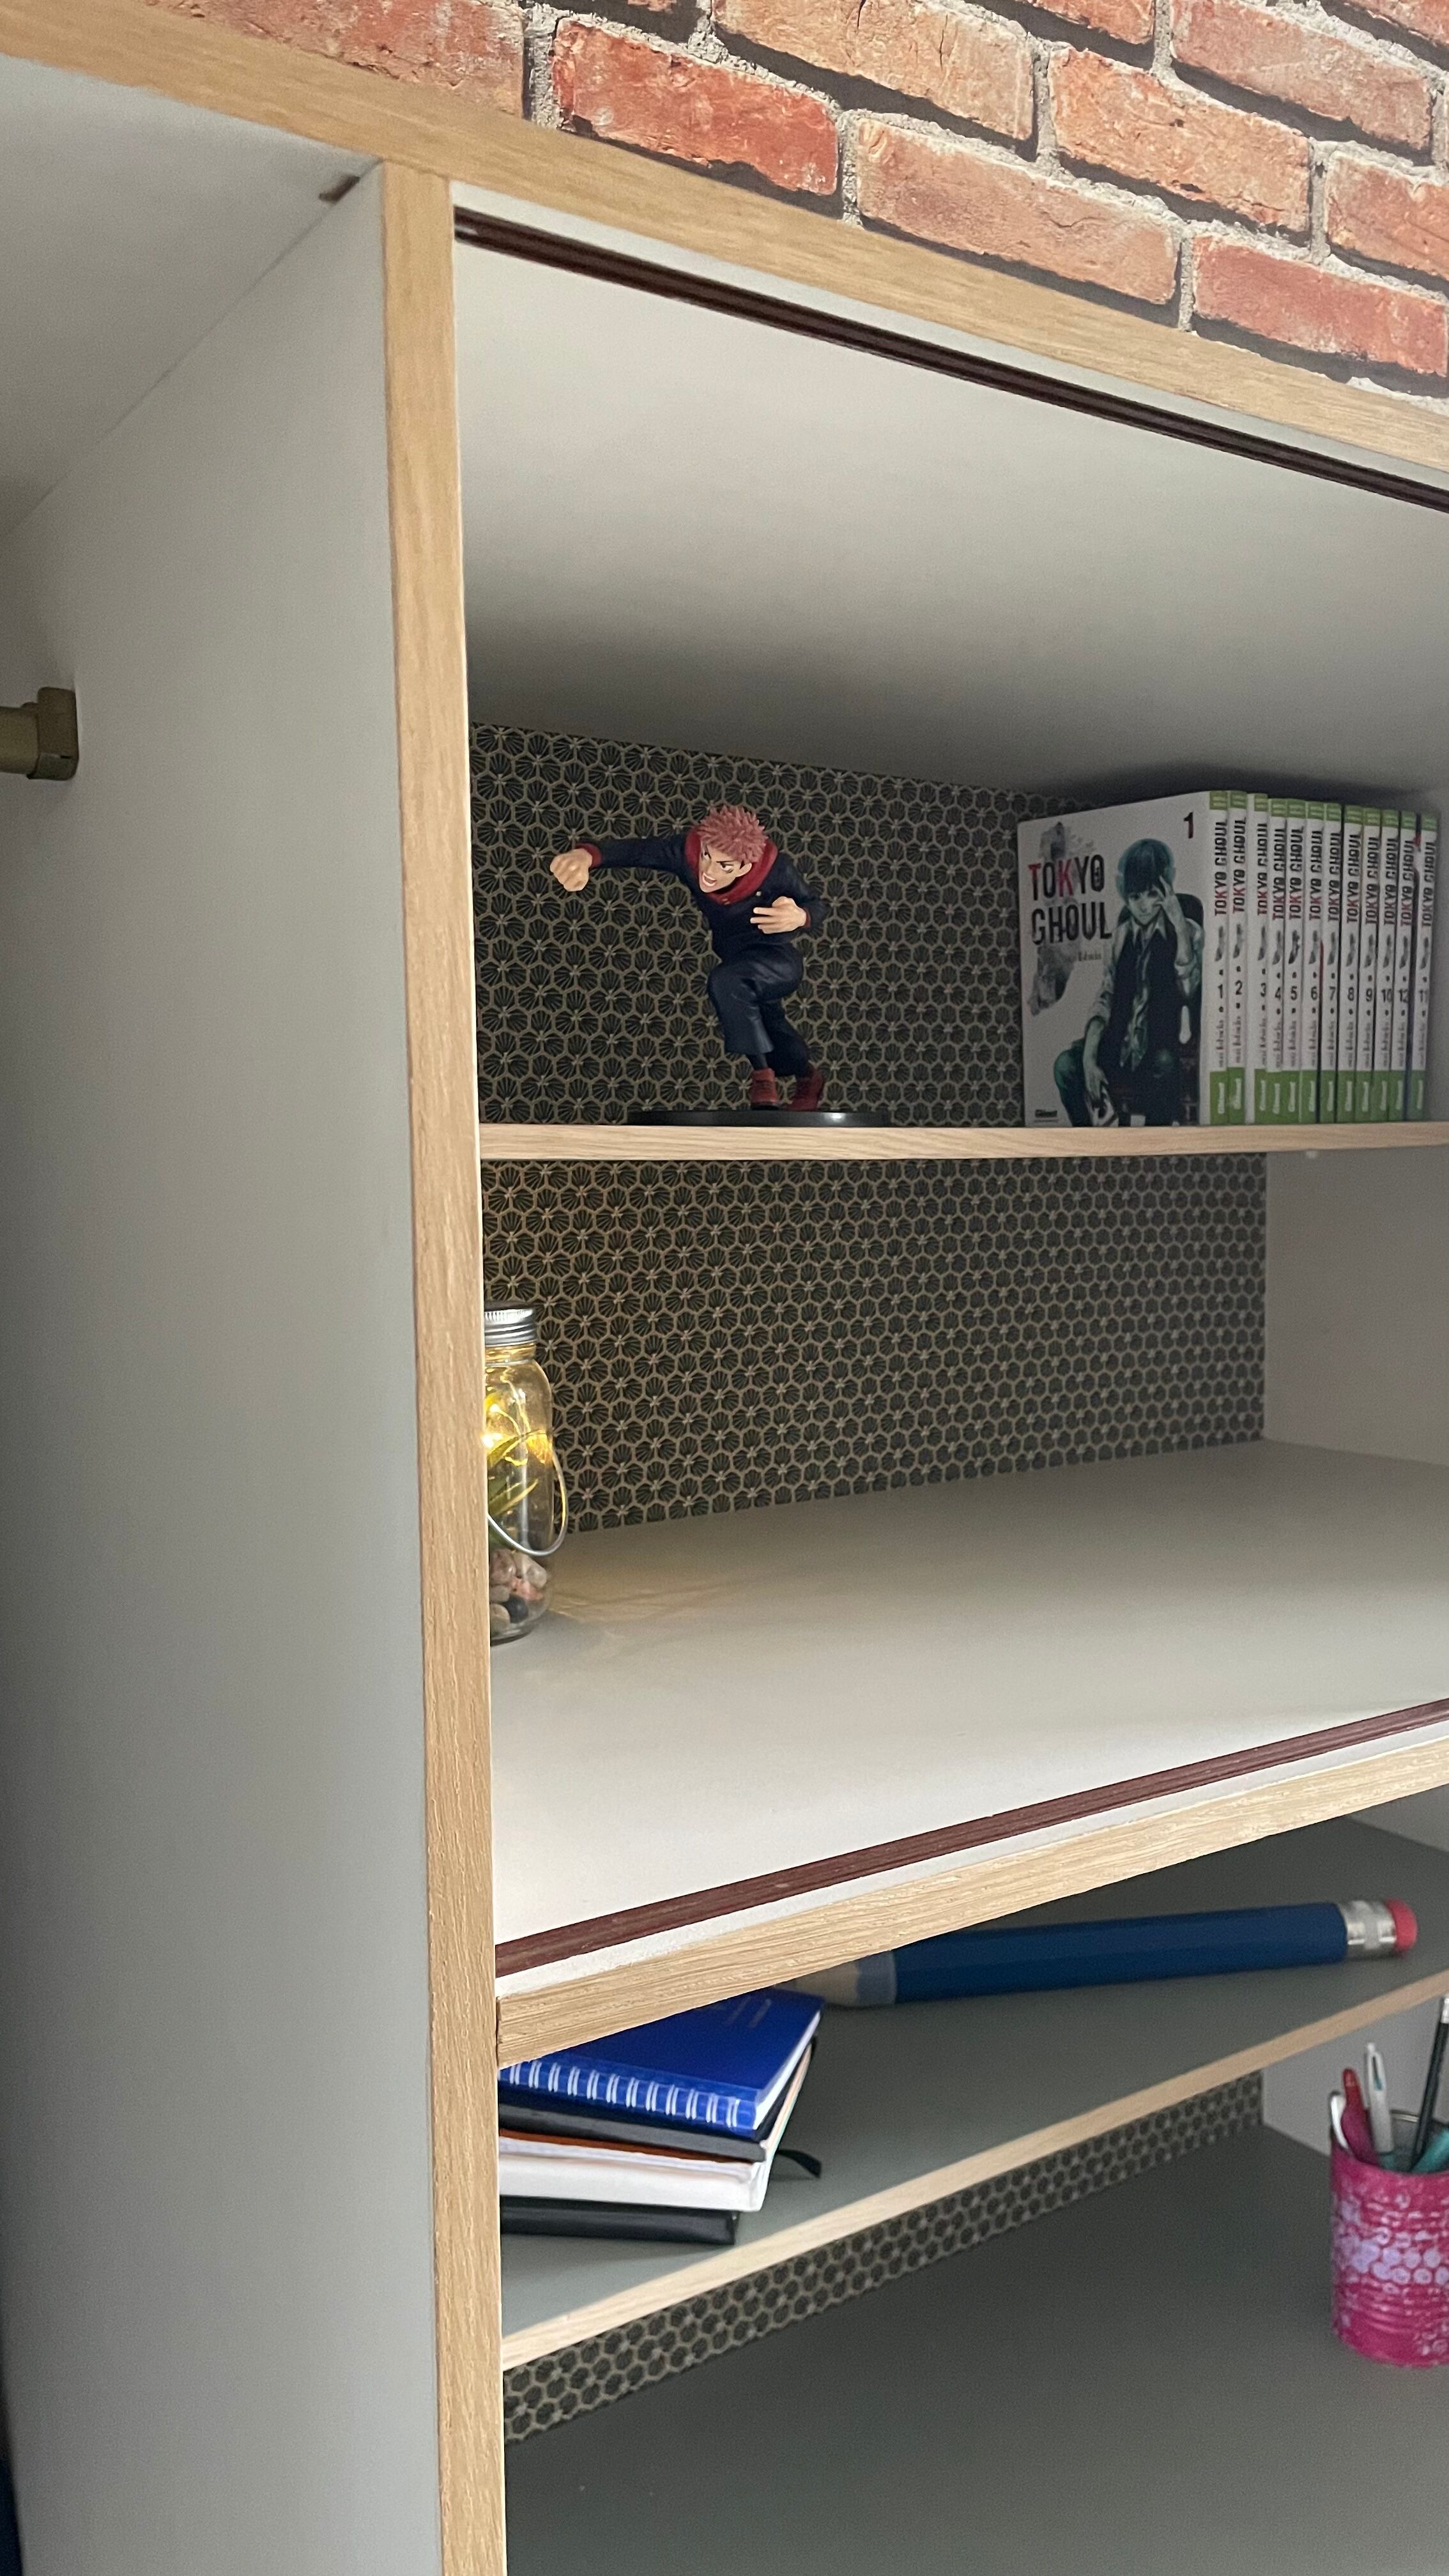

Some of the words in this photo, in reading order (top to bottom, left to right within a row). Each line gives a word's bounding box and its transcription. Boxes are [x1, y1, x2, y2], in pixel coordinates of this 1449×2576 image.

[1183, 812, 1194, 838] 1
[1215, 819, 1228, 866] GHOUL
[1234, 817, 1246, 864] GHOUL
[1290, 826, 1303, 872] GHOUL
[1310, 827, 1323, 873] GHOUL
[1027, 854, 1105, 901] TOKYO
[1215, 871, 1227, 916] TOKYO
[1233, 870, 1245, 914] TOKYO
[1257, 872, 1268, 916] TOKYO
[1273, 877, 1285, 920] TOKYO
[1289, 877, 1301, 920] TOKYO
[1309, 878, 1321, 920] TOKYO
[1328, 880, 1340, 922] TOKYO
[1347, 881, 1359, 924] TOKYO
[1365, 884, 1379, 924] TOKYO
[1384, 884, 1396, 925] TOKYO
[1400, 887, 1413, 926] TOKYO
[1422, 887, 1434, 928] TOKYO
[1031, 902, 1112, 946] GHOUL
[1218, 984, 1223, 999] 1
[1235, 980, 1243, 995] 2
[1261, 983, 1266, 997] 3
[1275, 986, 1281, 1000] 4
[1291, 986, 1298, 1000] 5
[1310, 986, 1317, 1000] 6
[1329, 986, 1336, 1000] 7
[1347, 987, 1354, 1001] 8
[1366, 988, 1373, 1002] 9
[1381, 989, 1392, 1002] 10
